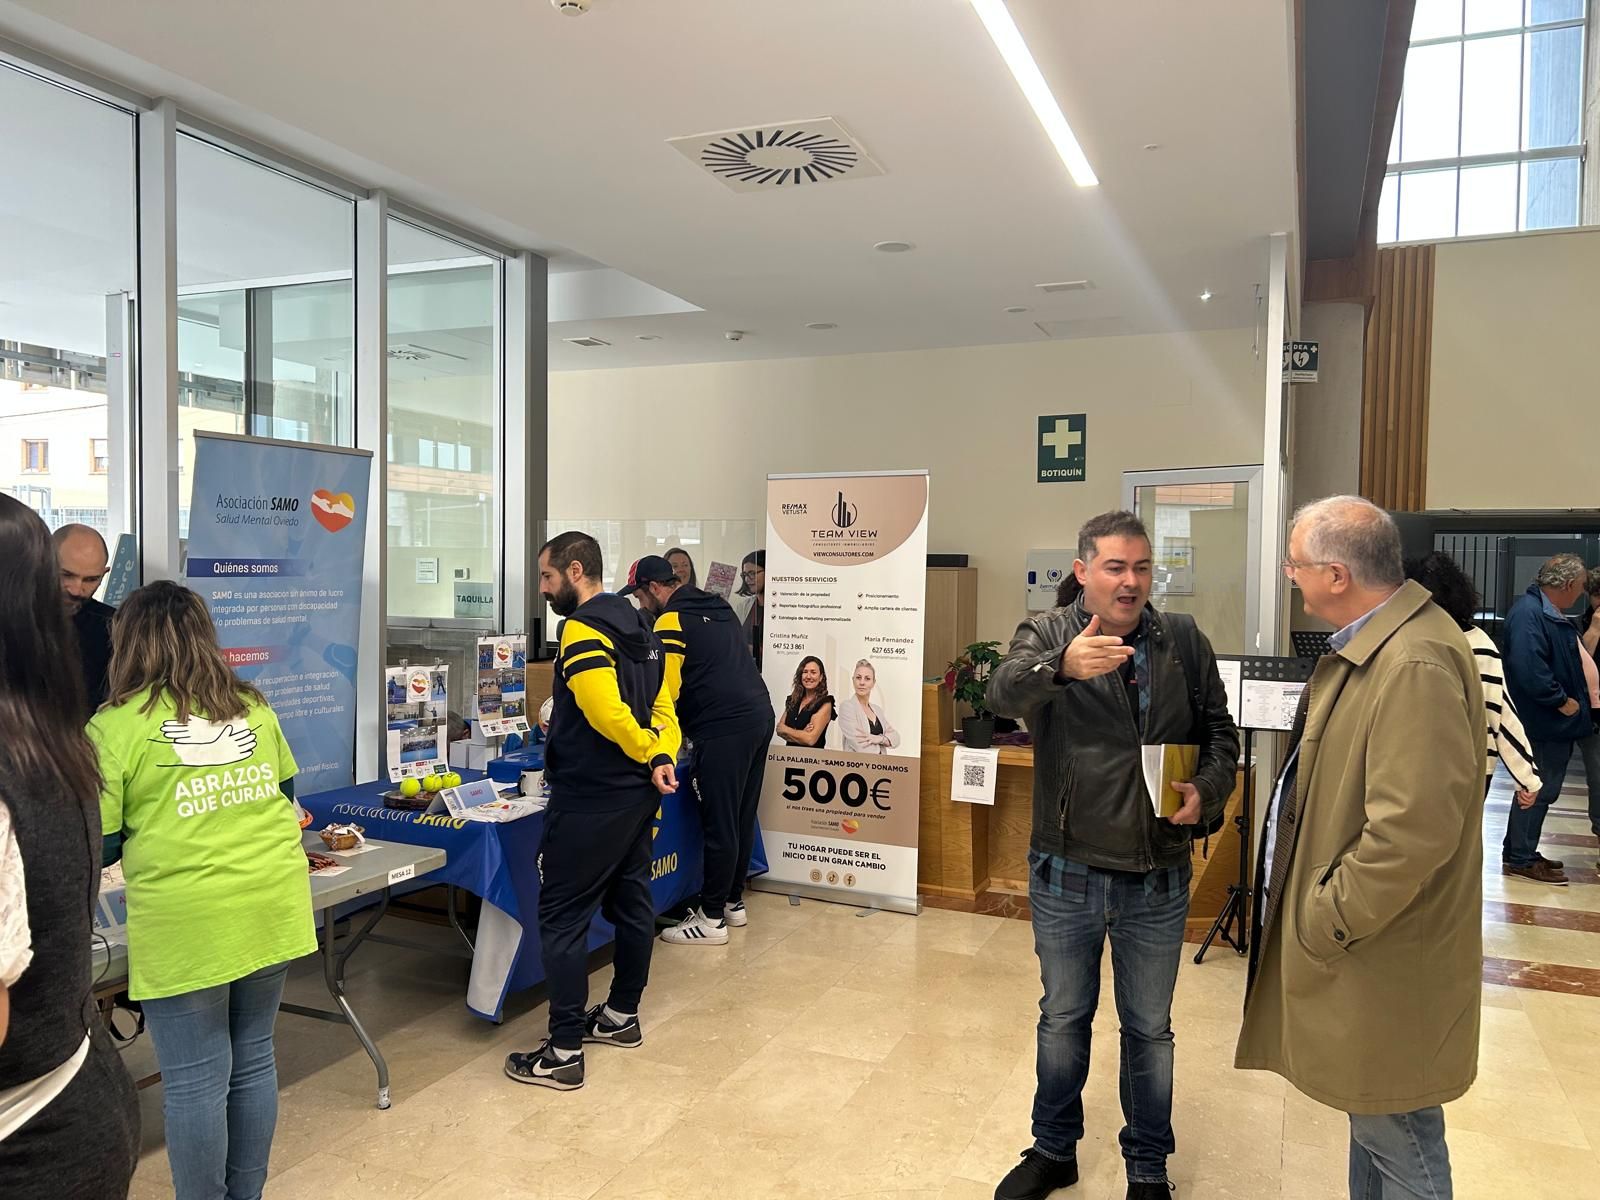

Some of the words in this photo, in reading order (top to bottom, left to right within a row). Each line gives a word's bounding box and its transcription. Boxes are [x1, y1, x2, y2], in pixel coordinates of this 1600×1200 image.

[1041, 468, 1082, 477] BOTIQUÍN
[216, 494, 268, 511] Asociación
[270, 496, 299, 512] SAMO
[216, 513, 240, 524] Salud
[241, 514, 272, 525] Mental
[274, 515, 299, 526] Oviedo
[811, 530, 844, 538] TEAM
[848, 530, 878, 538] VIEW
[214, 562, 249, 574] Quiénes
[251, 564, 278, 573] somos
[212, 591, 232, 599] SAMO
[456, 595, 493, 603] TAQUILLA
[212, 604, 244, 614] integrada
[246, 605, 258, 613] por
[299, 602, 338, 611] discapacidad
[224, 617, 261, 626] problemas
[229, 651, 269, 662] hacemos
[304, 684, 312, 692] de
[313, 682, 330, 690] salud
[314, 705, 344, 714] culturales
[787, 756, 820, 764] PALABRA:
[872, 764, 908, 773] DONAMOS
[174, 762, 274, 800] ABRAZOS
[782, 767, 891, 811] 500€
[178, 797, 218, 818] QUE
[220, 782, 278, 807] CURAN
[800, 844, 827, 853] HOGAR
[828, 848, 853, 856] PUEDE
[651, 852, 678, 880] SAMO
[782, 851, 805, 860] INICIO
[832, 857, 853, 866] GRAN
[855, 860, 886, 870] CAMBIO
[391, 870, 405, 880] MESA
